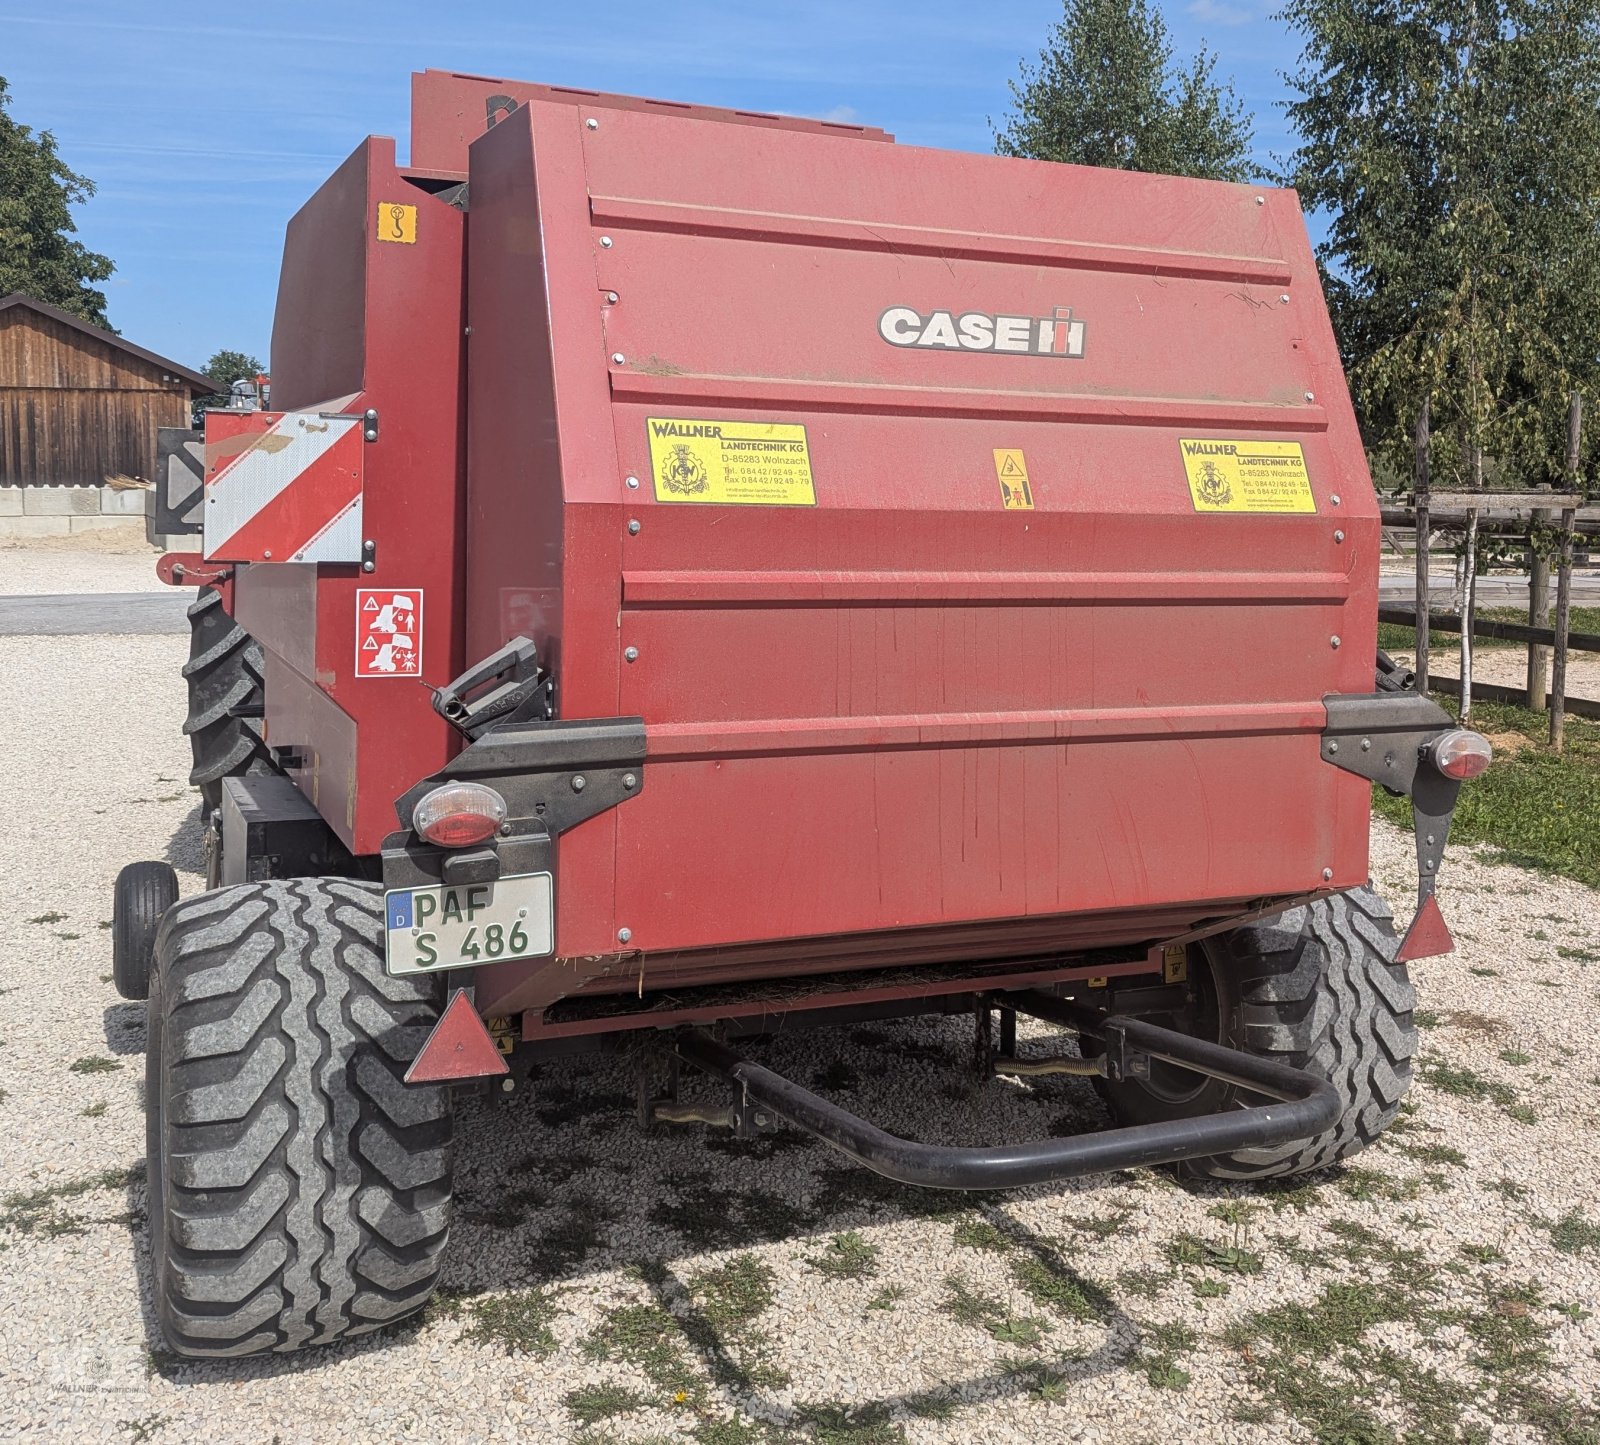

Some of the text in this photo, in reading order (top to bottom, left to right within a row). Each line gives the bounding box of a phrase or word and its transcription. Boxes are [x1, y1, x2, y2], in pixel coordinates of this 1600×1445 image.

[880, 308, 1031, 351] CASE
[651, 421, 722, 439] WALLNER
[720, 441, 804, 453] LANDTECHNIK KG
[1182, 441, 1238, 456] WALLNER
[721, 454, 806, 465] D-85283 Wolnzach
[1237, 458, 1303, 467] LANDTECHNIK KG
[724, 475, 739, 484] Fax
[1239, 469, 1305, 478] D-85283 Wolnzach
[414, 886, 489, 928] PAF
[396, 915, 405, 927] D
[415, 920, 529, 967] S 486
